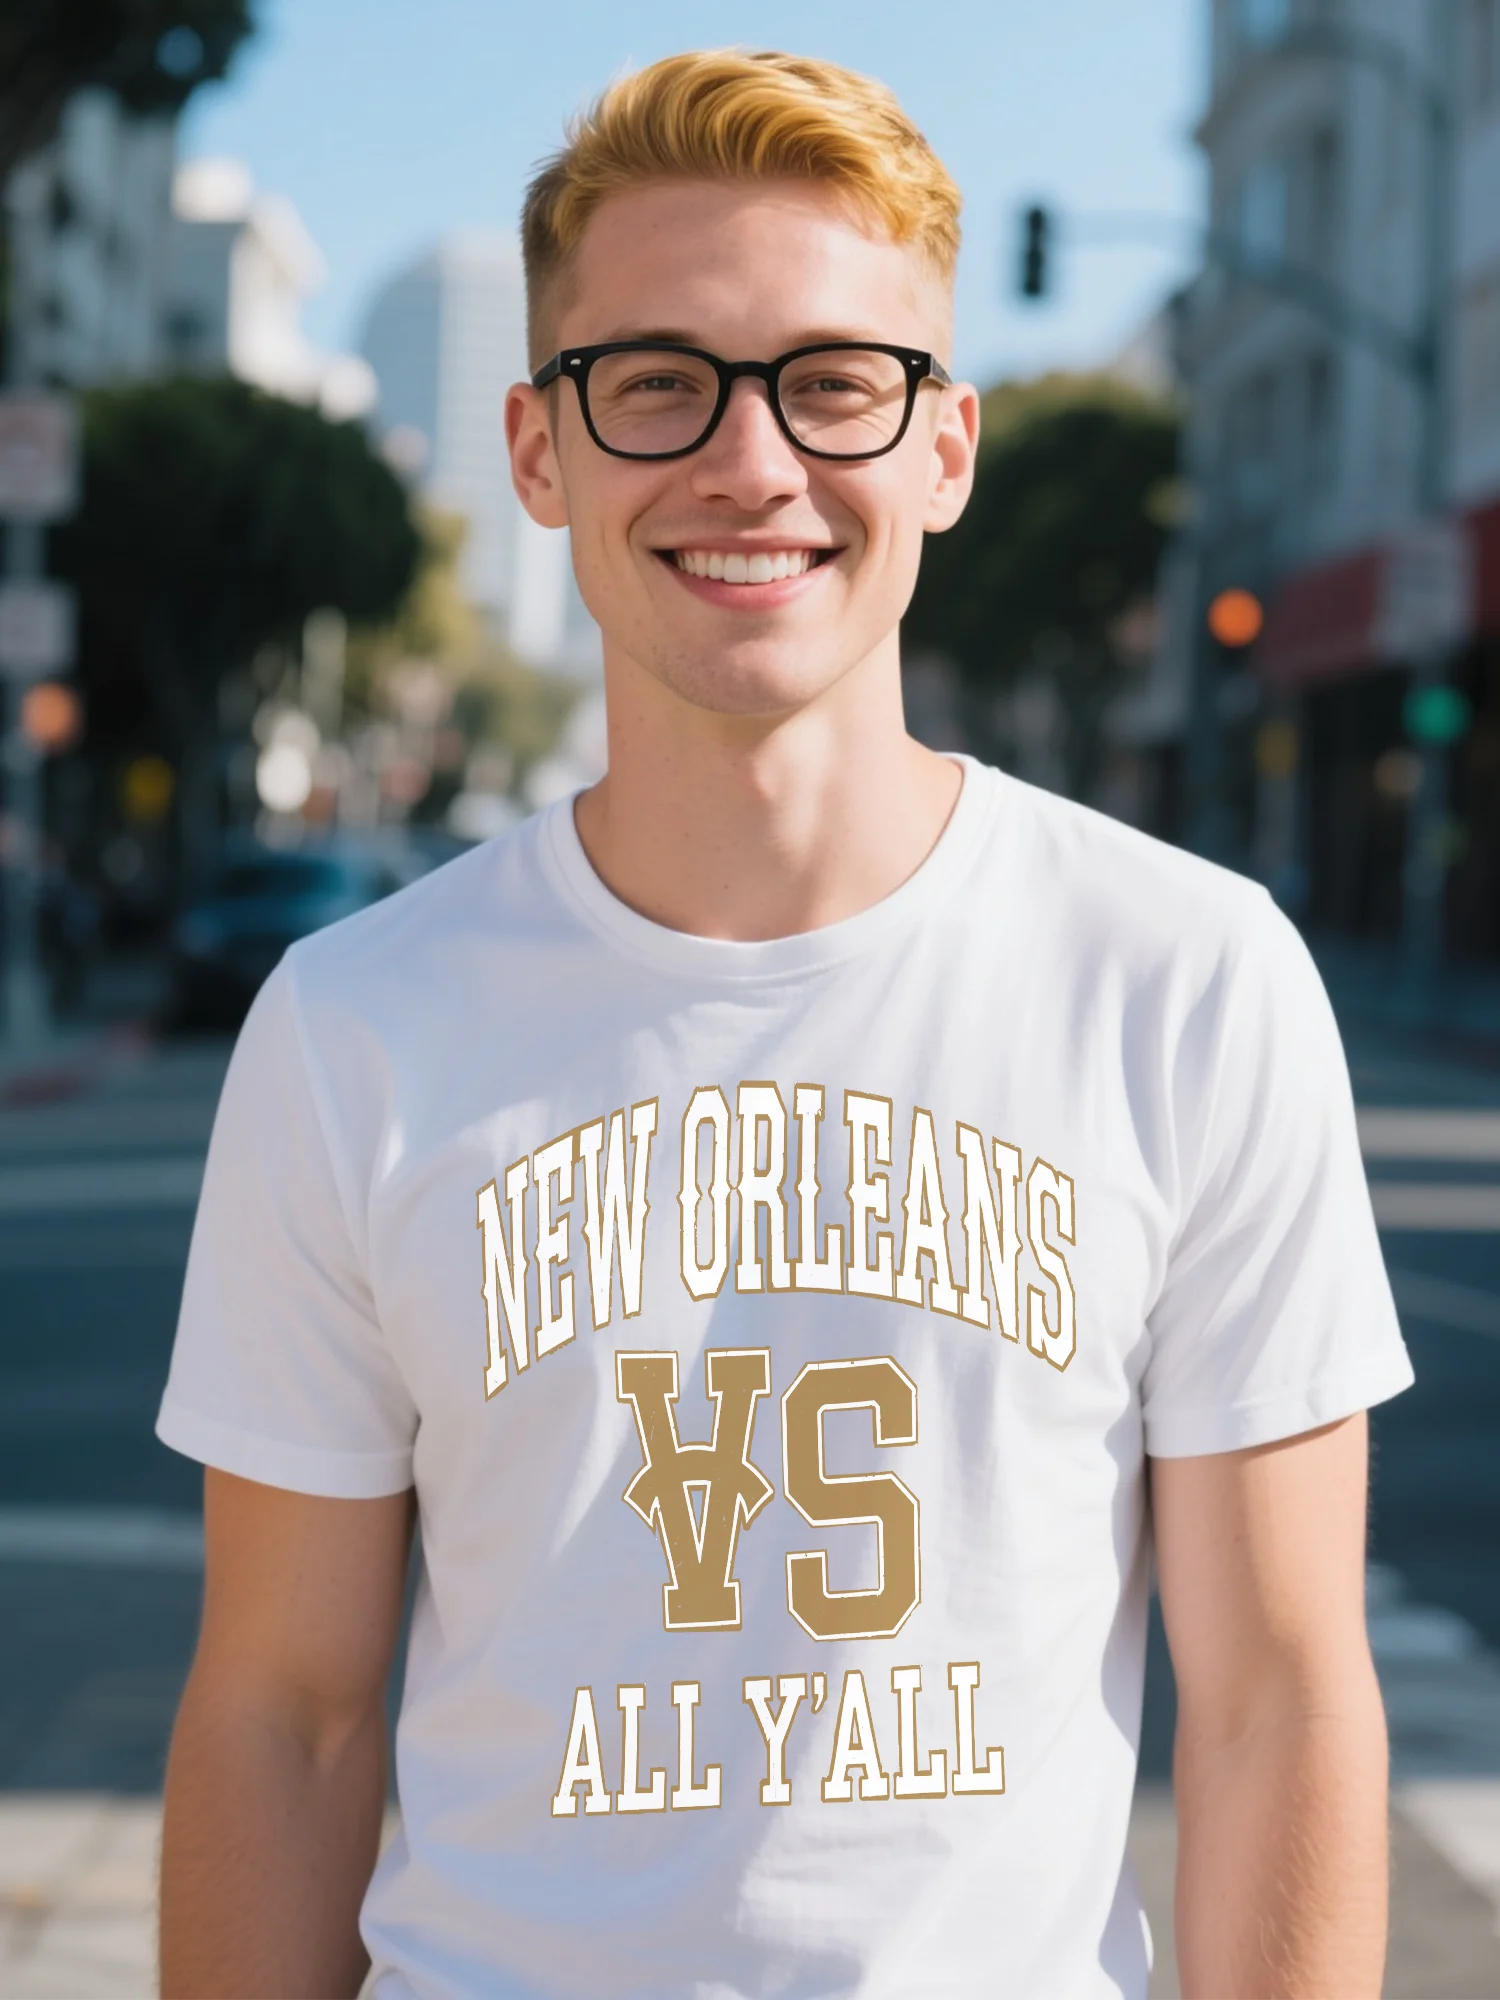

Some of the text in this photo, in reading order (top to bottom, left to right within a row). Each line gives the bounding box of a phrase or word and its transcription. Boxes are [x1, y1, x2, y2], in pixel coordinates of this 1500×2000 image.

[476, 1080, 1077, 1402] NEW ORLEANS
[551, 1660, 1006, 1818] ALL Y'ALL
